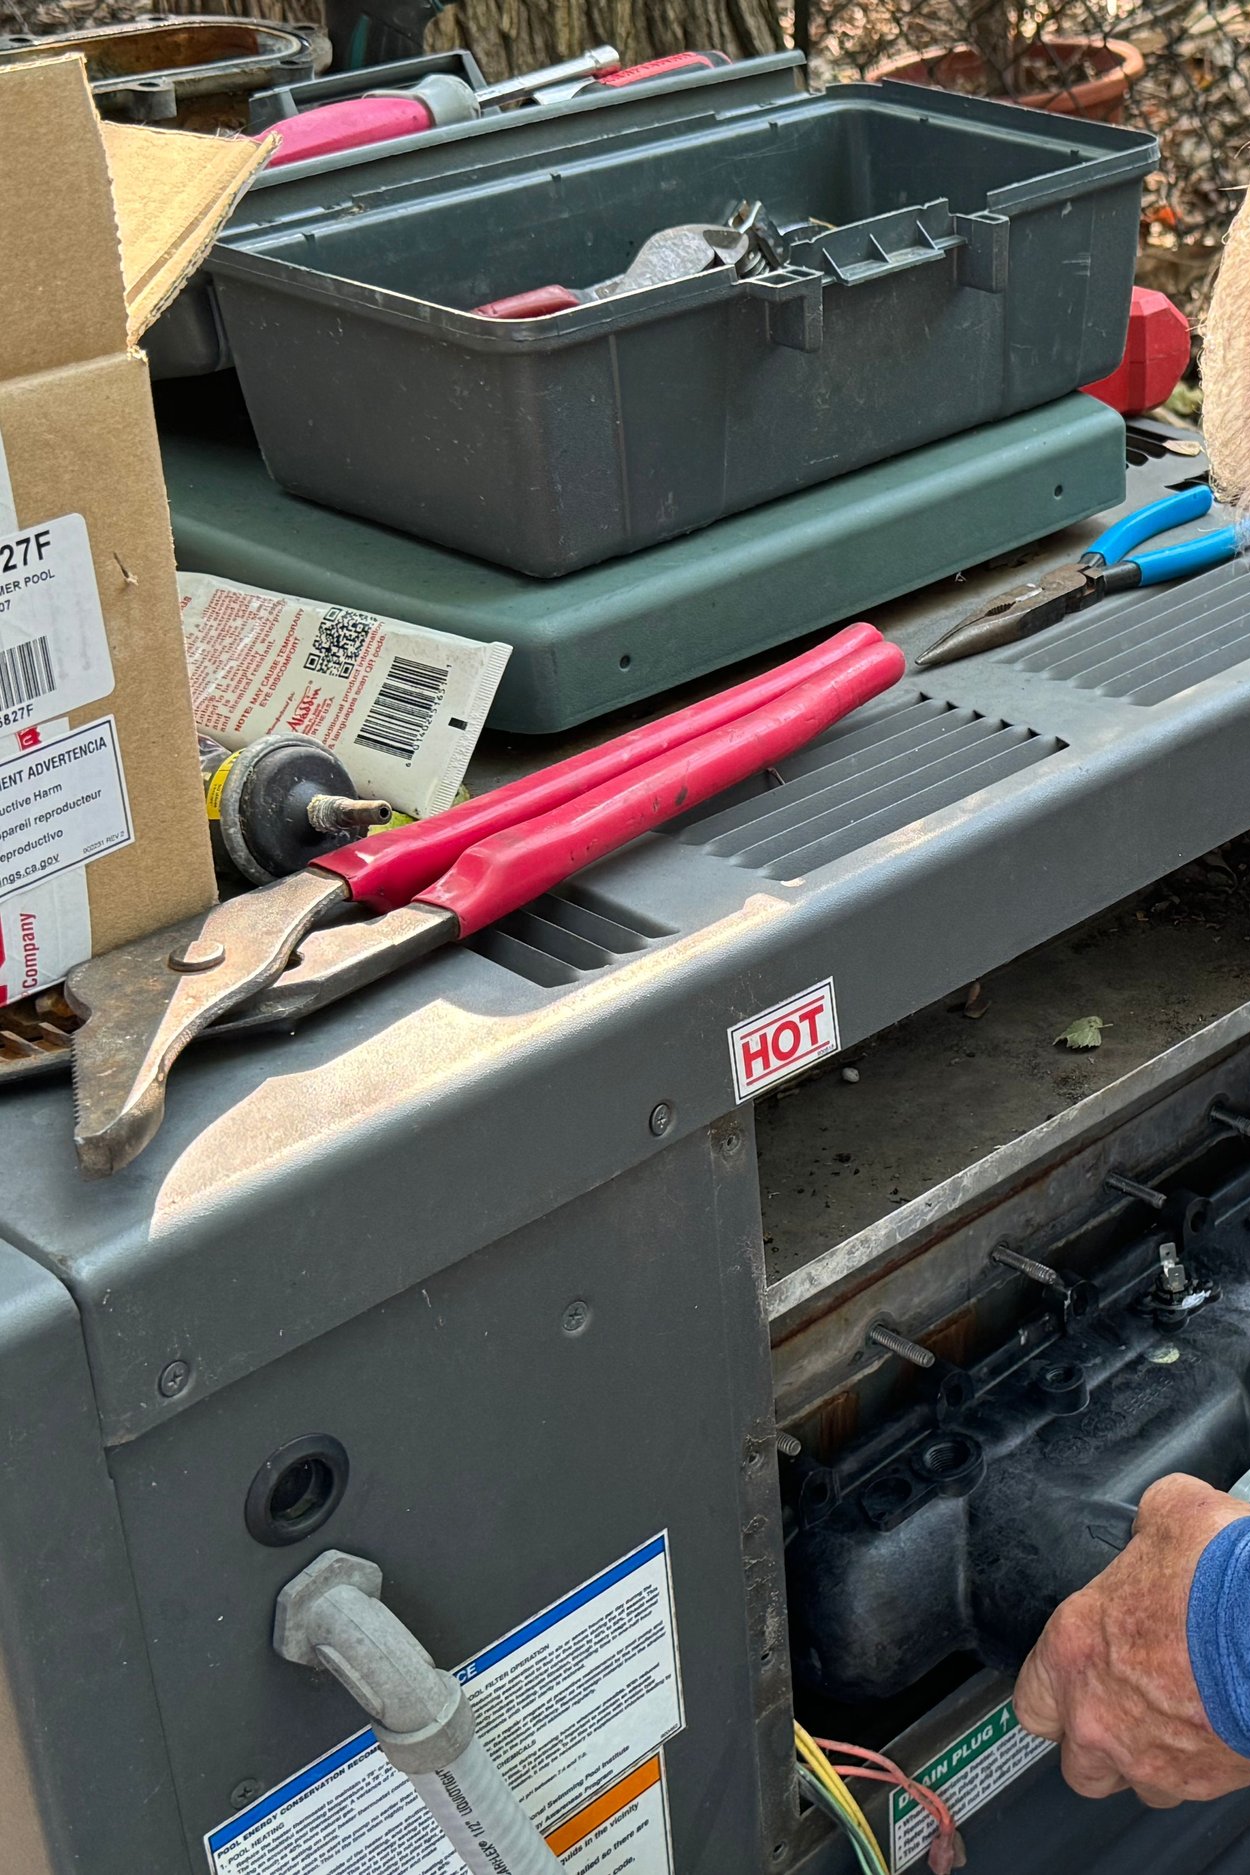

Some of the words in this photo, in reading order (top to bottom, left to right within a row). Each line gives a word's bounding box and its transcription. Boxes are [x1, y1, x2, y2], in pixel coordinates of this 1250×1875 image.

[25, 568, 55, 588] POOL
[209, 712, 224, 729] and
[230, 649, 261, 694] completely
[216, 715, 232, 732] and
[226, 677, 253, 714] chemical
[250, 638, 276, 676] resistant.
[233, 705, 253, 732] NOTE:
[249, 687, 264, 705] MAY
[260, 659, 280, 687] CAUSE
[276, 608, 305, 657] TEMPORARY
[258, 691, 273, 707] EYE
[268, 636, 301, 691] DISCOMFORT
[320, 703, 345, 745] additional
[340, 674, 358, 703] product
[356, 620, 384, 667] information
[330, 696, 359, 742] languages
[354, 674, 368, 695] scan
[364, 659, 375, 673] QR
[372, 632, 387, 657] code.
[282, 683, 323, 733] Aladdin
[27, 736, 107, 780] ADVERTENCIA
[33, 783, 63, 802] Harm
[34, 789, 102, 827] reproducteur
[19, 913, 40, 989] Company
[742, 1004, 824, 1080] HOT
[485, 1669, 509, 1691] FILTER
[510, 1642, 549, 1674] OPERATION
[496, 1737, 536, 1771] CHEMICALS
[547, 1776, 583, 1808] Swimming
[585, 1764, 600, 1781] Pool
[601, 1743, 629, 1769] Institute
[898, 1760, 948, 1810] DAIN
[952, 1724, 994, 1767] PLUG
[217, 1837, 241, 1859] POOL
[243, 1812, 277, 1842] ENERGY
[279, 1767, 345, 1817] CONSERVATION
[544, 1790, 582, 1823] Awareness
[584, 1768, 613, 1794] Program
[228, 1845, 249, 1865] POOL
[251, 1820, 284, 1849] HEATING
[584, 1837, 594, 1848] in
[594, 1825, 609, 1840] the
[609, 1802, 640, 1828] vicinity
[601, 1847, 613, 1860] so
[613, 1829, 635, 1851] there
[636, 1818, 650, 1834] are
[613, 1856, 636, 1875] code,
